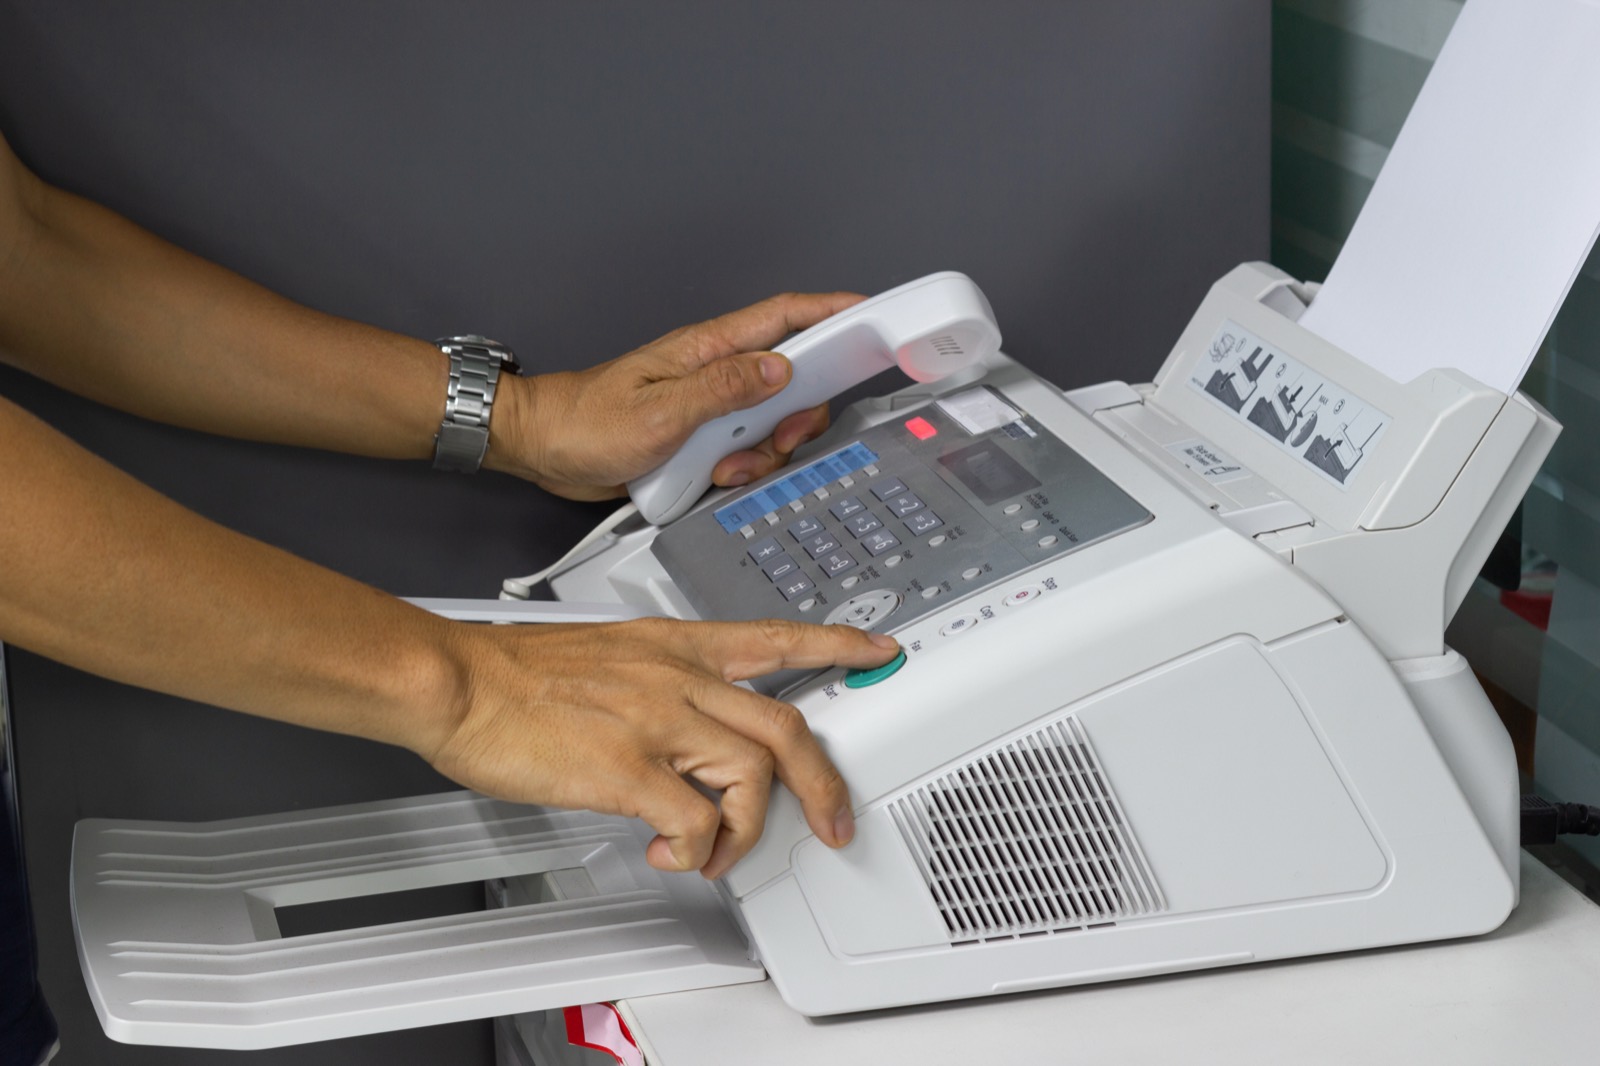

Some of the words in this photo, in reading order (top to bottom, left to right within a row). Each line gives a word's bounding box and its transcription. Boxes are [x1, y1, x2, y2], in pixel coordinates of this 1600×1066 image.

[884, 485, 901, 495] 1
[843, 504, 859, 515] 4
[900, 502, 918, 513] 2
[799, 523, 818, 535] 7
[858, 521, 877, 532] 5
[917, 519, 935, 530] 3
[815, 542, 833, 553] 8
[874, 539, 893, 550] 6
[773, 564, 791, 576] 0
[830, 559, 849, 571] 9
[787, 581, 806, 594] #
[1041, 577, 1058, 591] Stop
[979, 605, 995, 620] Copy
[909, 640, 923, 652] Fax
[822, 684, 839, 700] Start
